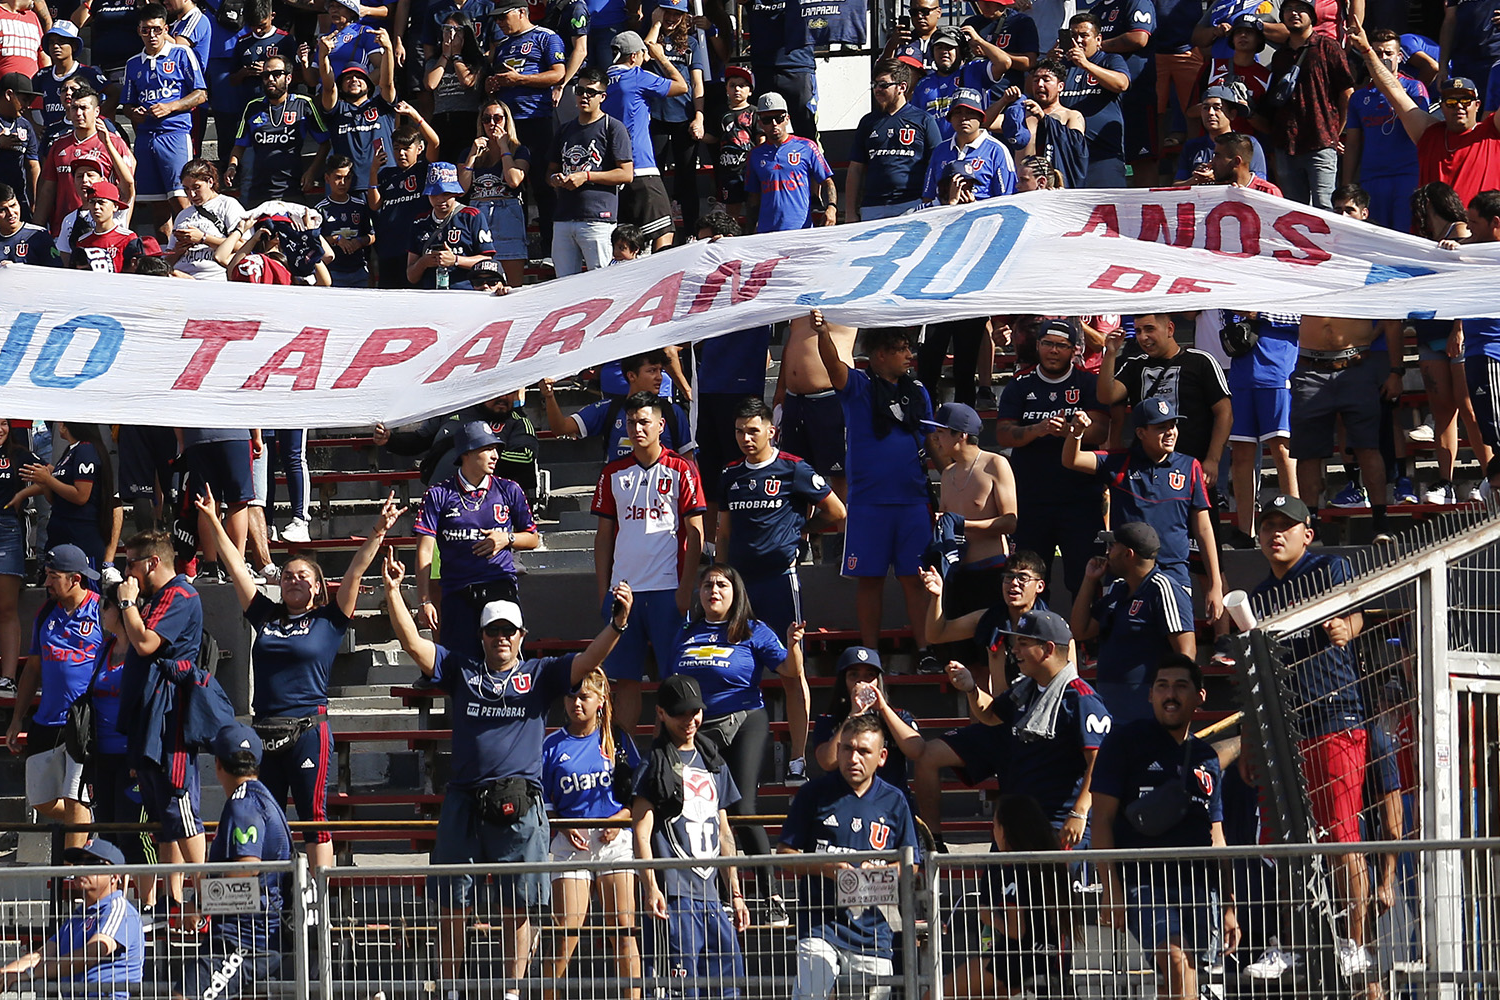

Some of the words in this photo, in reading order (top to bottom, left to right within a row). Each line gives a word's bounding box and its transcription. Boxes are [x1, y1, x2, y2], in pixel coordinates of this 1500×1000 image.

[138, 80, 179, 103] Claro
[254, 126, 295, 145] Claro
[171, 255, 791, 391] TAPARAN
[795, 204, 1030, 306] 30
[728, 499, 782, 510] ETROBRAS
[441, 527, 509, 541] CHILE
[678, 659, 731, 667] CHEVROLET
[480, 706, 526, 718] PETROBRAS
[225, 884, 252, 892] VDS
